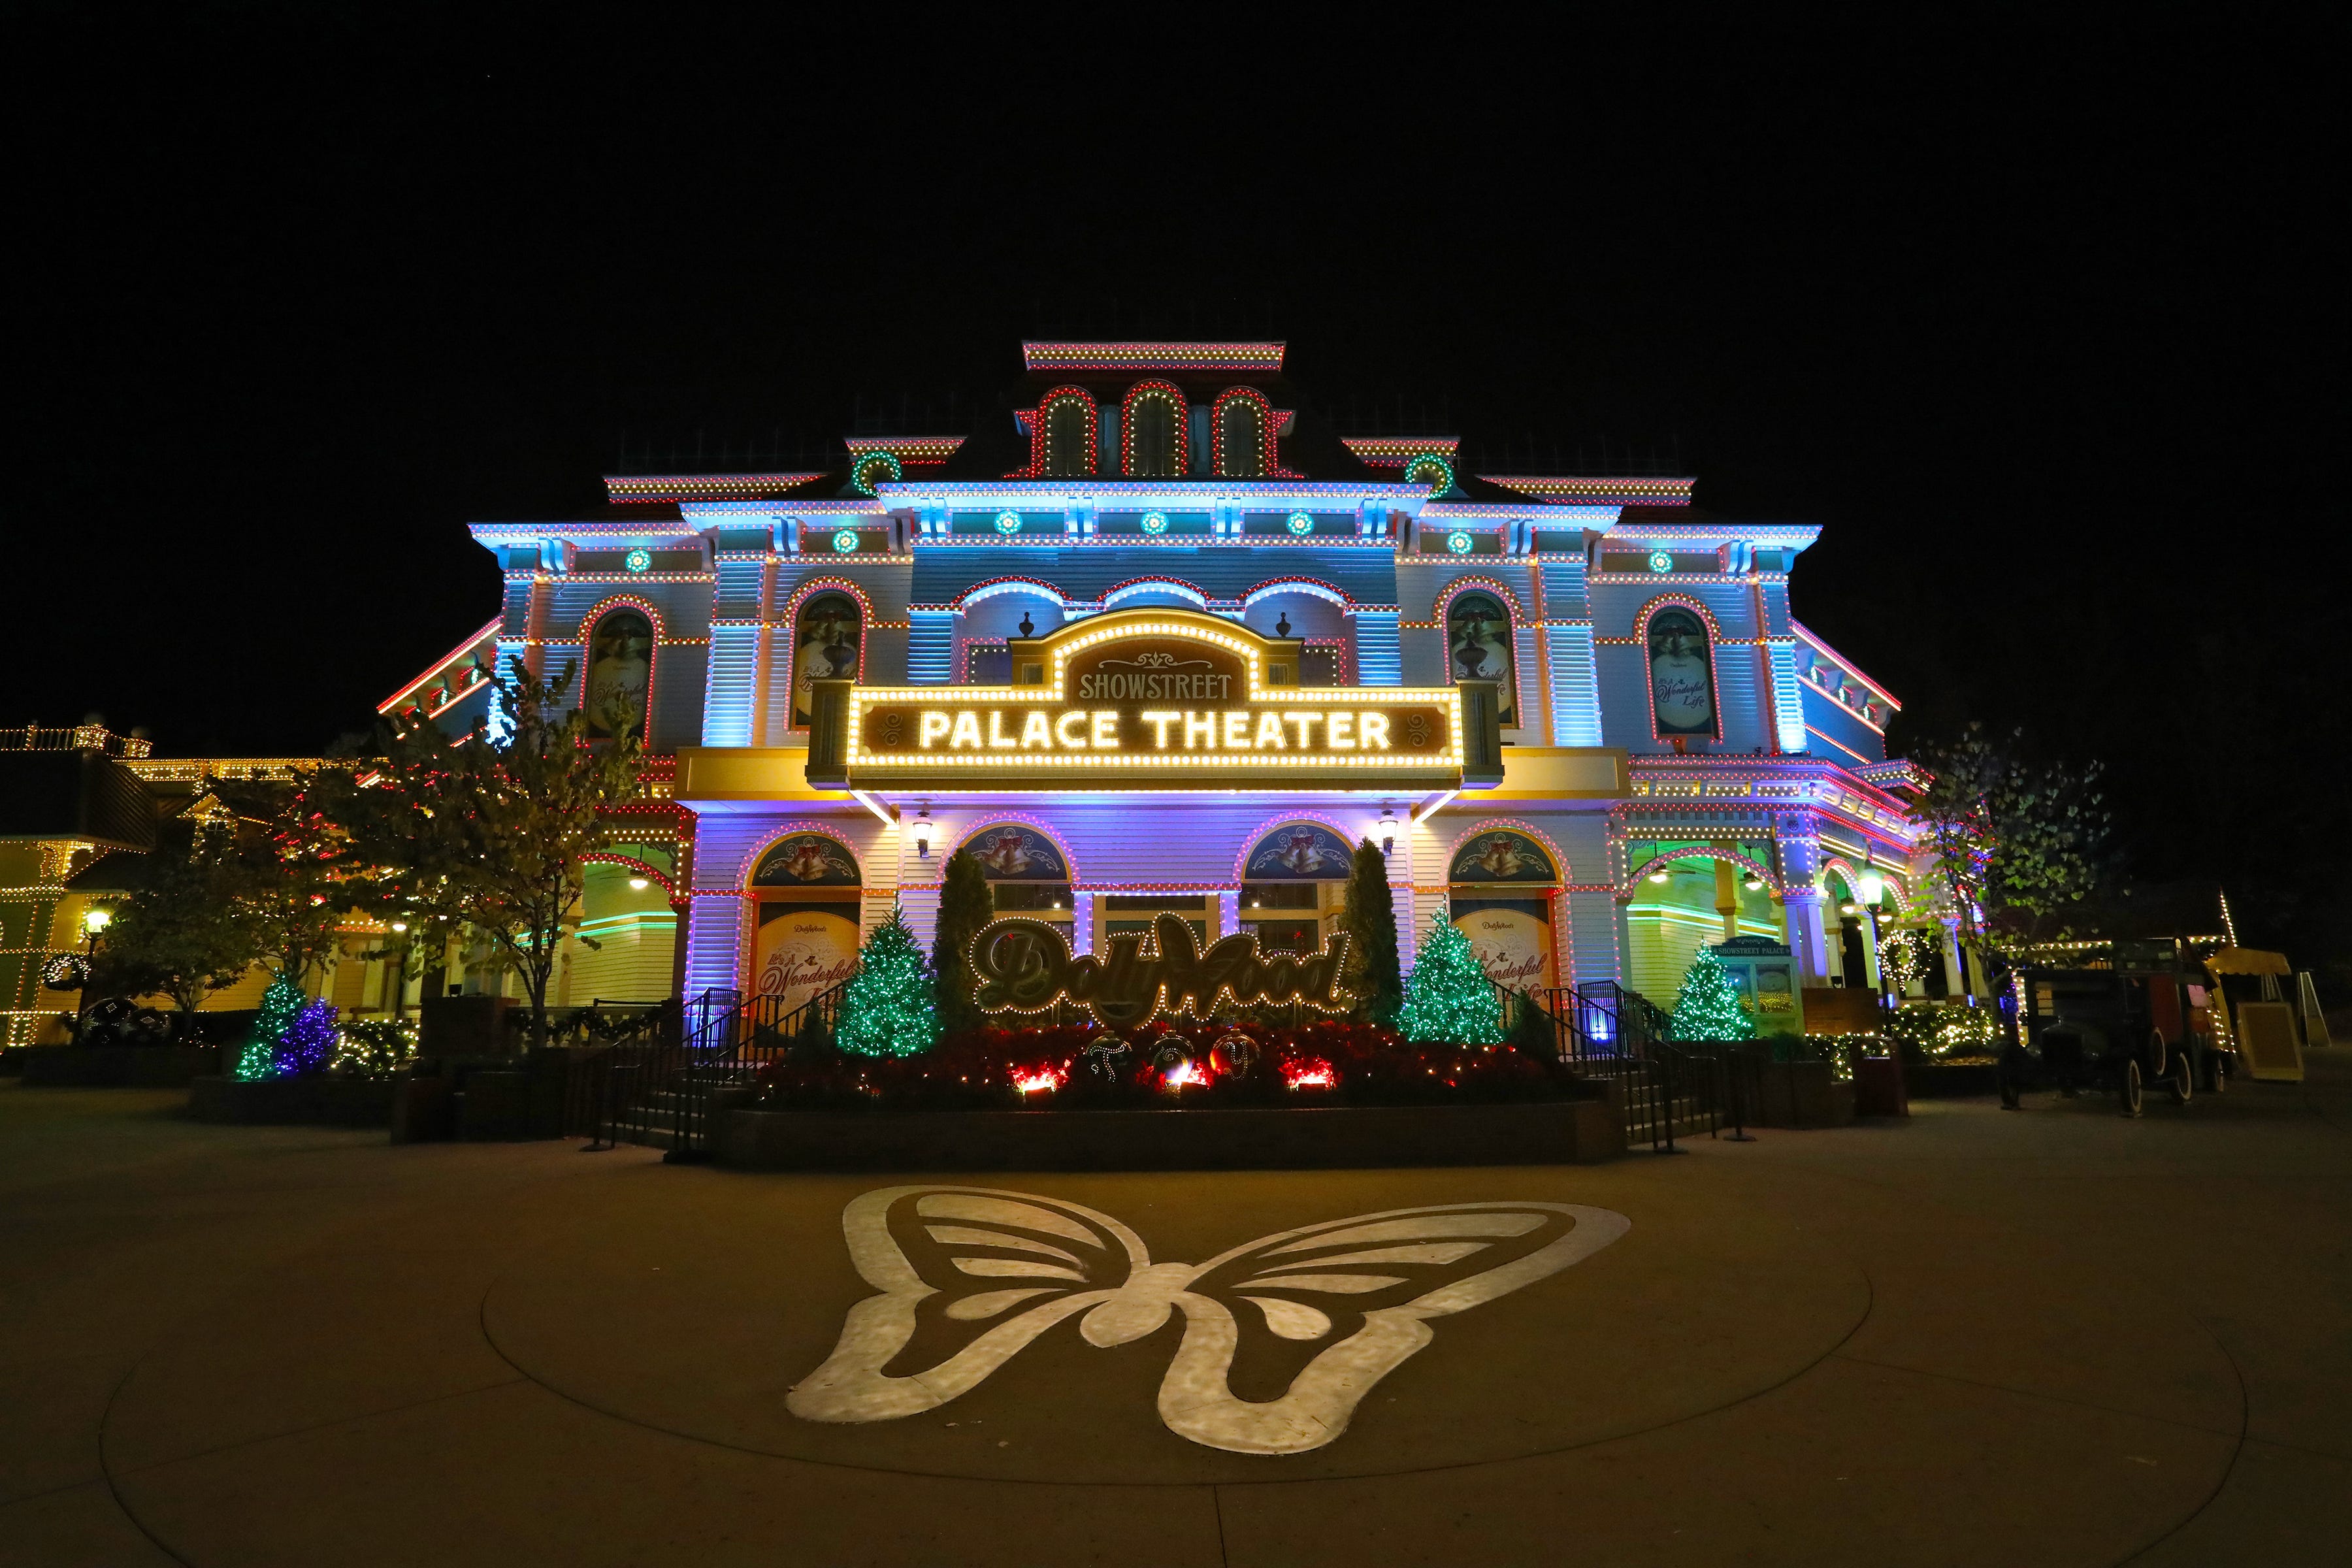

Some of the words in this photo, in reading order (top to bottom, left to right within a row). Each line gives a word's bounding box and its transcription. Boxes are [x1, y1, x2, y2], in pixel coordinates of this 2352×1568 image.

[1079, 674, 1232, 699] SHOWSTREET
[1655, 680, 1705, 704] Wonderful
[1682, 695, 1705, 709] Life
[919, 711, 1119, 749] PALACE
[1141, 711, 1392, 749] THEATER
[759, 957, 859, 1001] Wonderful
[1484, 953, 1548, 983] onderful
